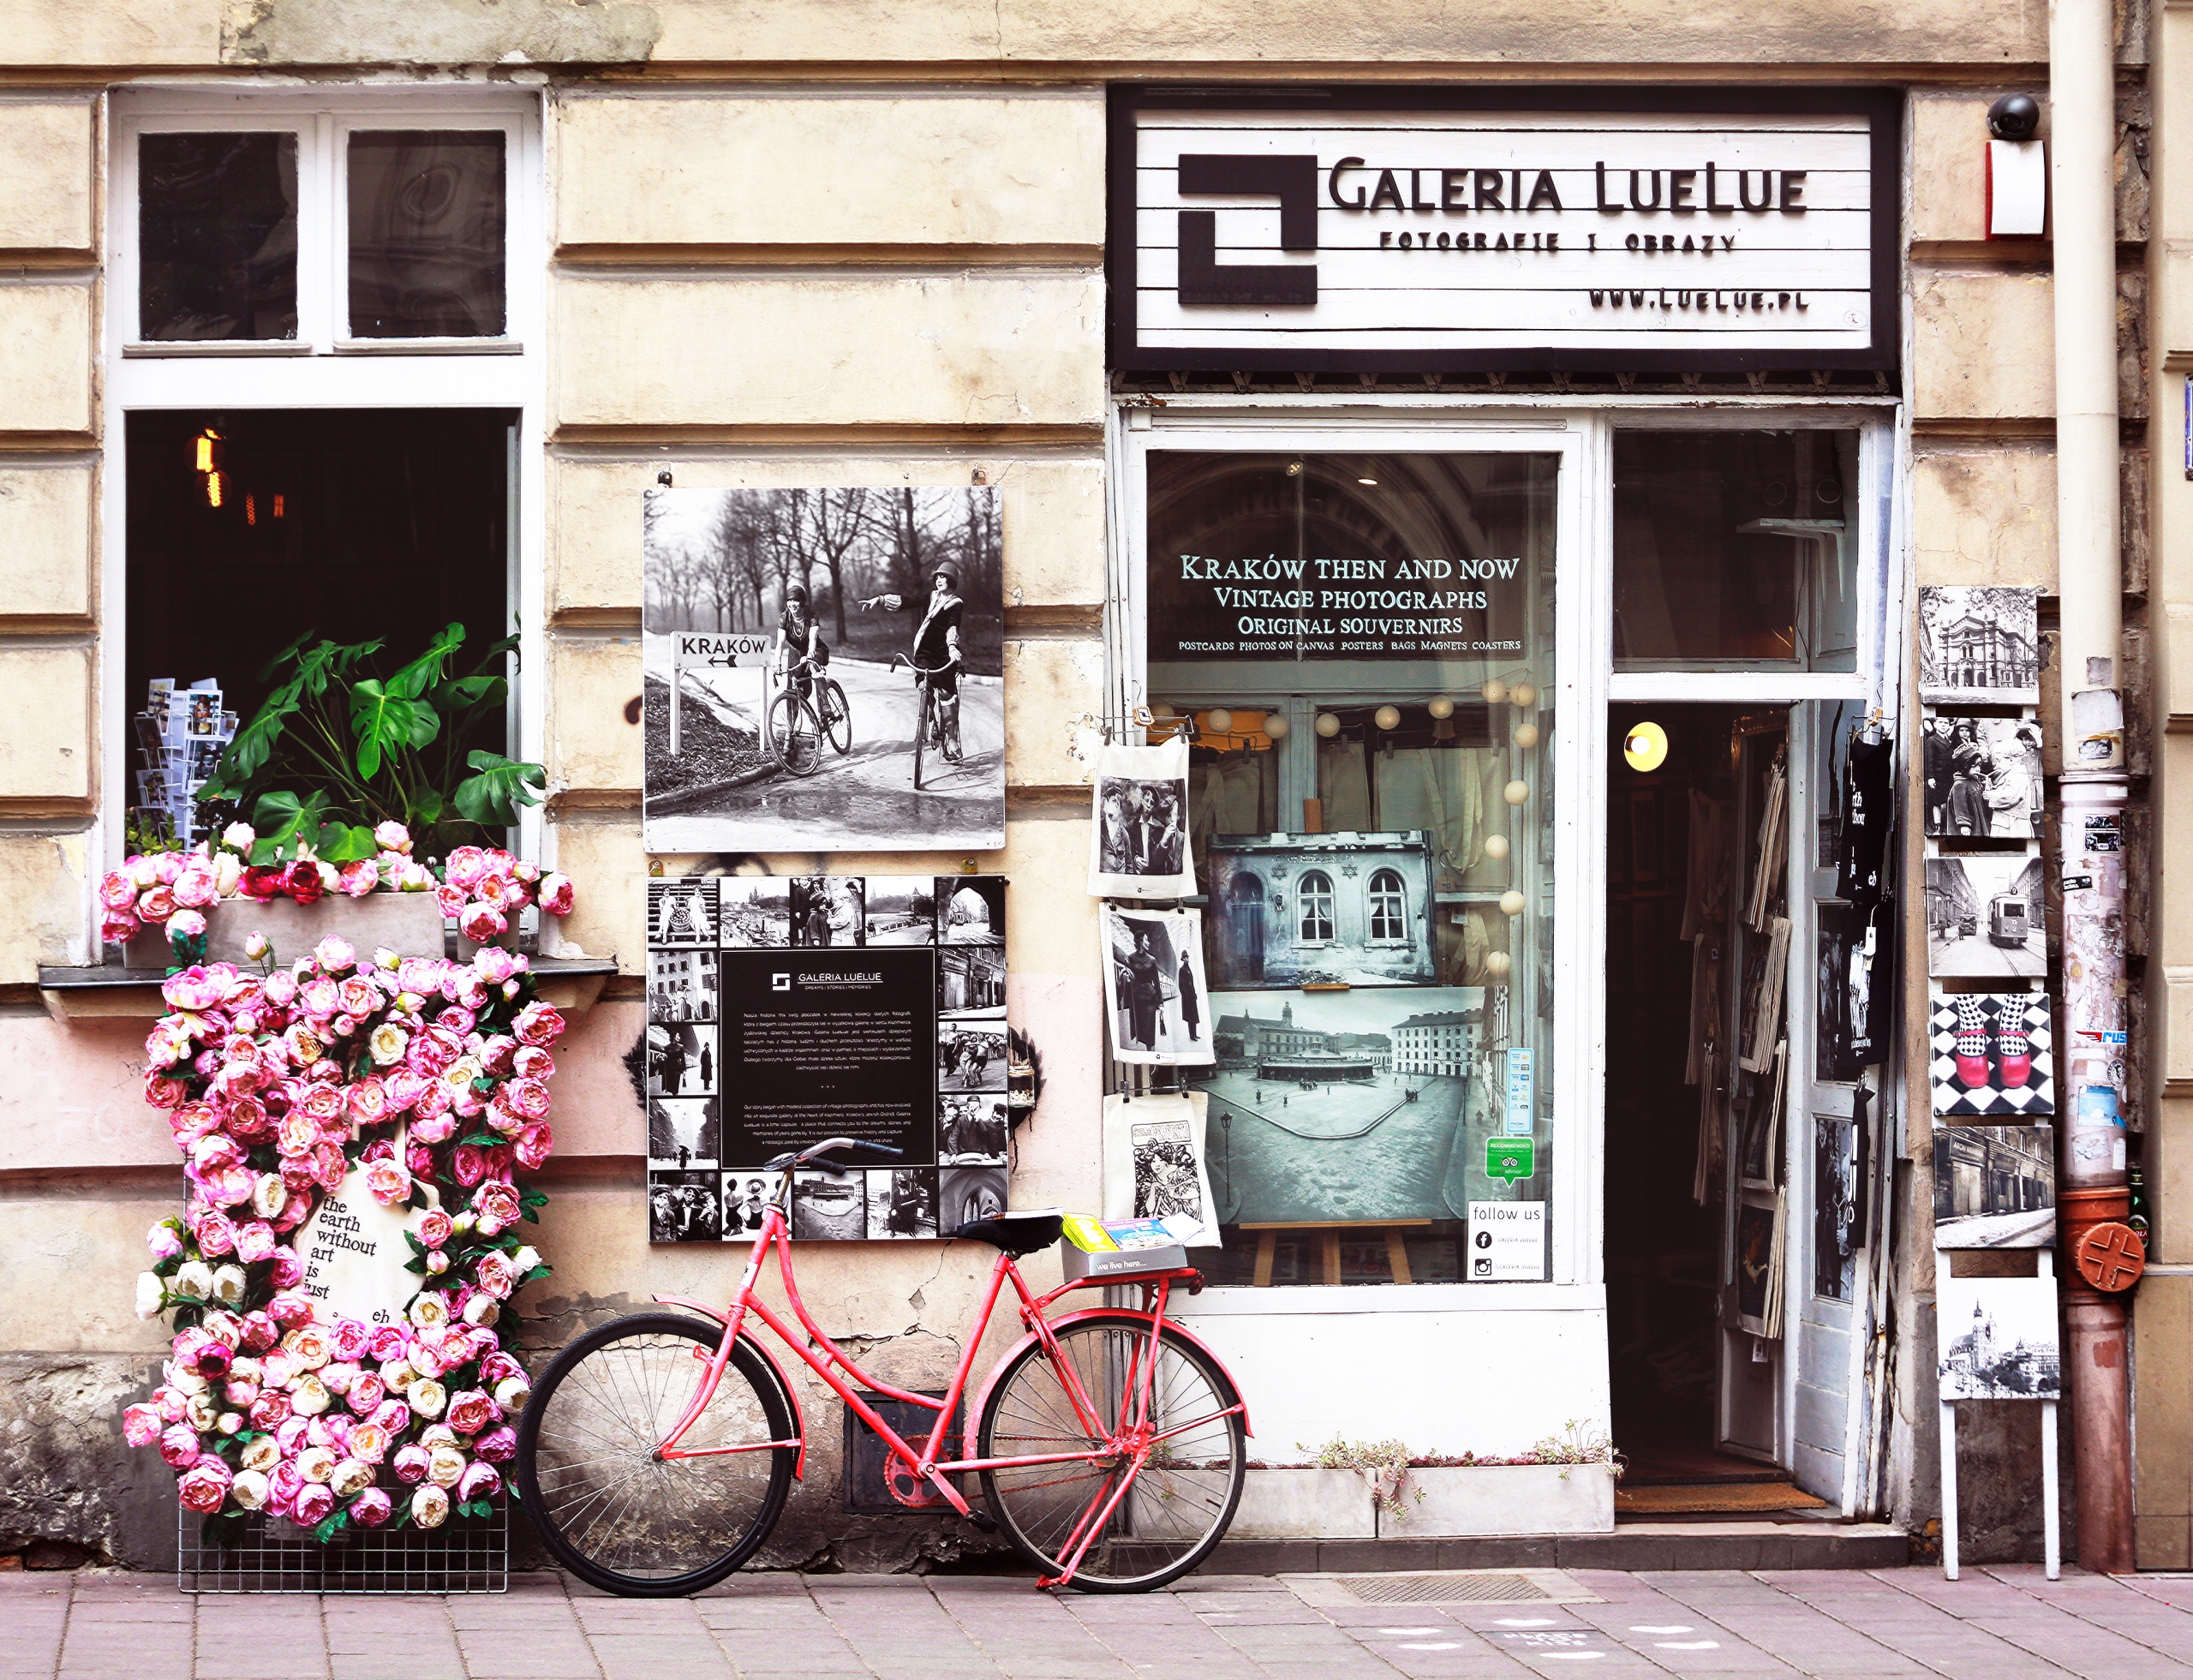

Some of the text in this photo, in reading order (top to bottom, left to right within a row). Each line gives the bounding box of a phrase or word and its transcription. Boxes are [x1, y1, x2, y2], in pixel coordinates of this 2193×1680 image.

[1328, 157, 1808, 212] GALERIA LUELUE
[1379, 231, 1737, 252] FOTOGRAFIE I OBRAZY
[1589, 288, 1809, 311] WWW.LUELUE.PL
[1180, 553, 1521, 580] KRAKÓW THEN AND NOW
[1213, 587, 1488, 610] VINTAGE PHOTOGRAPHS
[1238, 615, 1463, 636] ORIGINAL SOUVERNIRS
[682, 636, 766, 655] KRAKÓW
[1179, 640, 1523, 651] POSTCARDS PHOTOS ON CANVAS POSTERS BAGS MAGNETS COASTERS
[798, 972, 881, 982] GALERIA LUELUE
[323, 1196, 347, 1213] the
[1473, 1206, 1540, 1220] follow us
[320, 1212, 361, 1232] earth
[317, 1229, 377, 1257] without
[311, 1247, 335, 1263] art
[305, 1261, 320, 1277] is
[1109, 1261, 1122, 1270] live
[372, 1309, 390, 1324] eh
